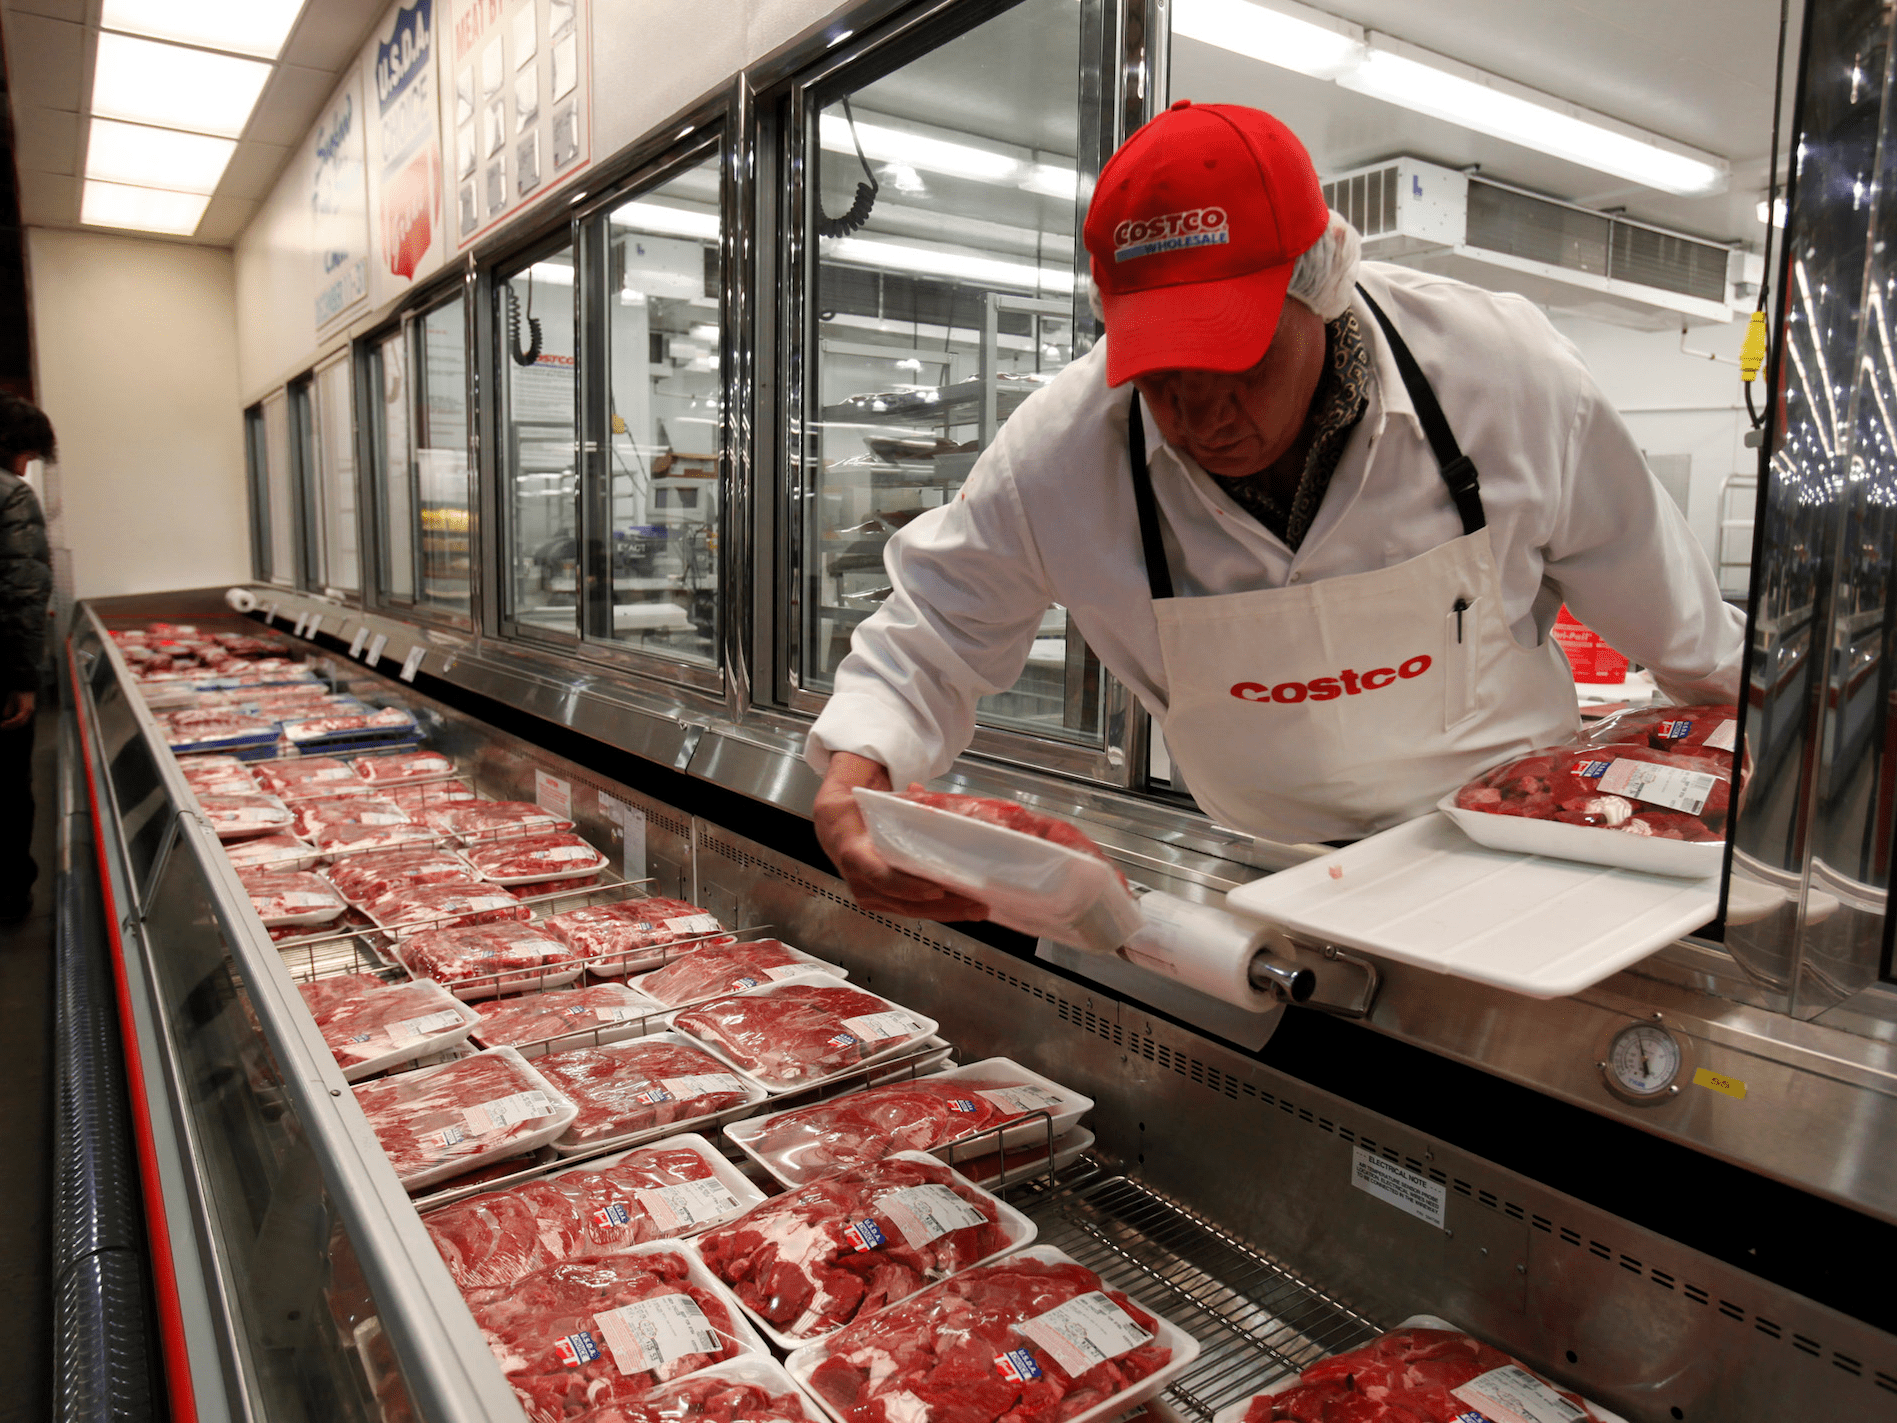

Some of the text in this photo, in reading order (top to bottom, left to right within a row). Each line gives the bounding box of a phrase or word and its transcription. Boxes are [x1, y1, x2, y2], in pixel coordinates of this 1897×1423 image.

[378, 10, 430, 101] U.S.D.A.
[1114, 206, 1228, 248] COSTCO
[1145, 232, 1227, 254] WHOLESALE
[1368, 1155, 1427, 1188] ELECTRICAL NOTE
[864, 1218, 881, 1242] U.S.D.A.
[572, 1336, 588, 1358] CHOICE
[1011, 1353, 1030, 1376] CHOICE
[1018, 1348, 1037, 1374] U.S.D.A.
